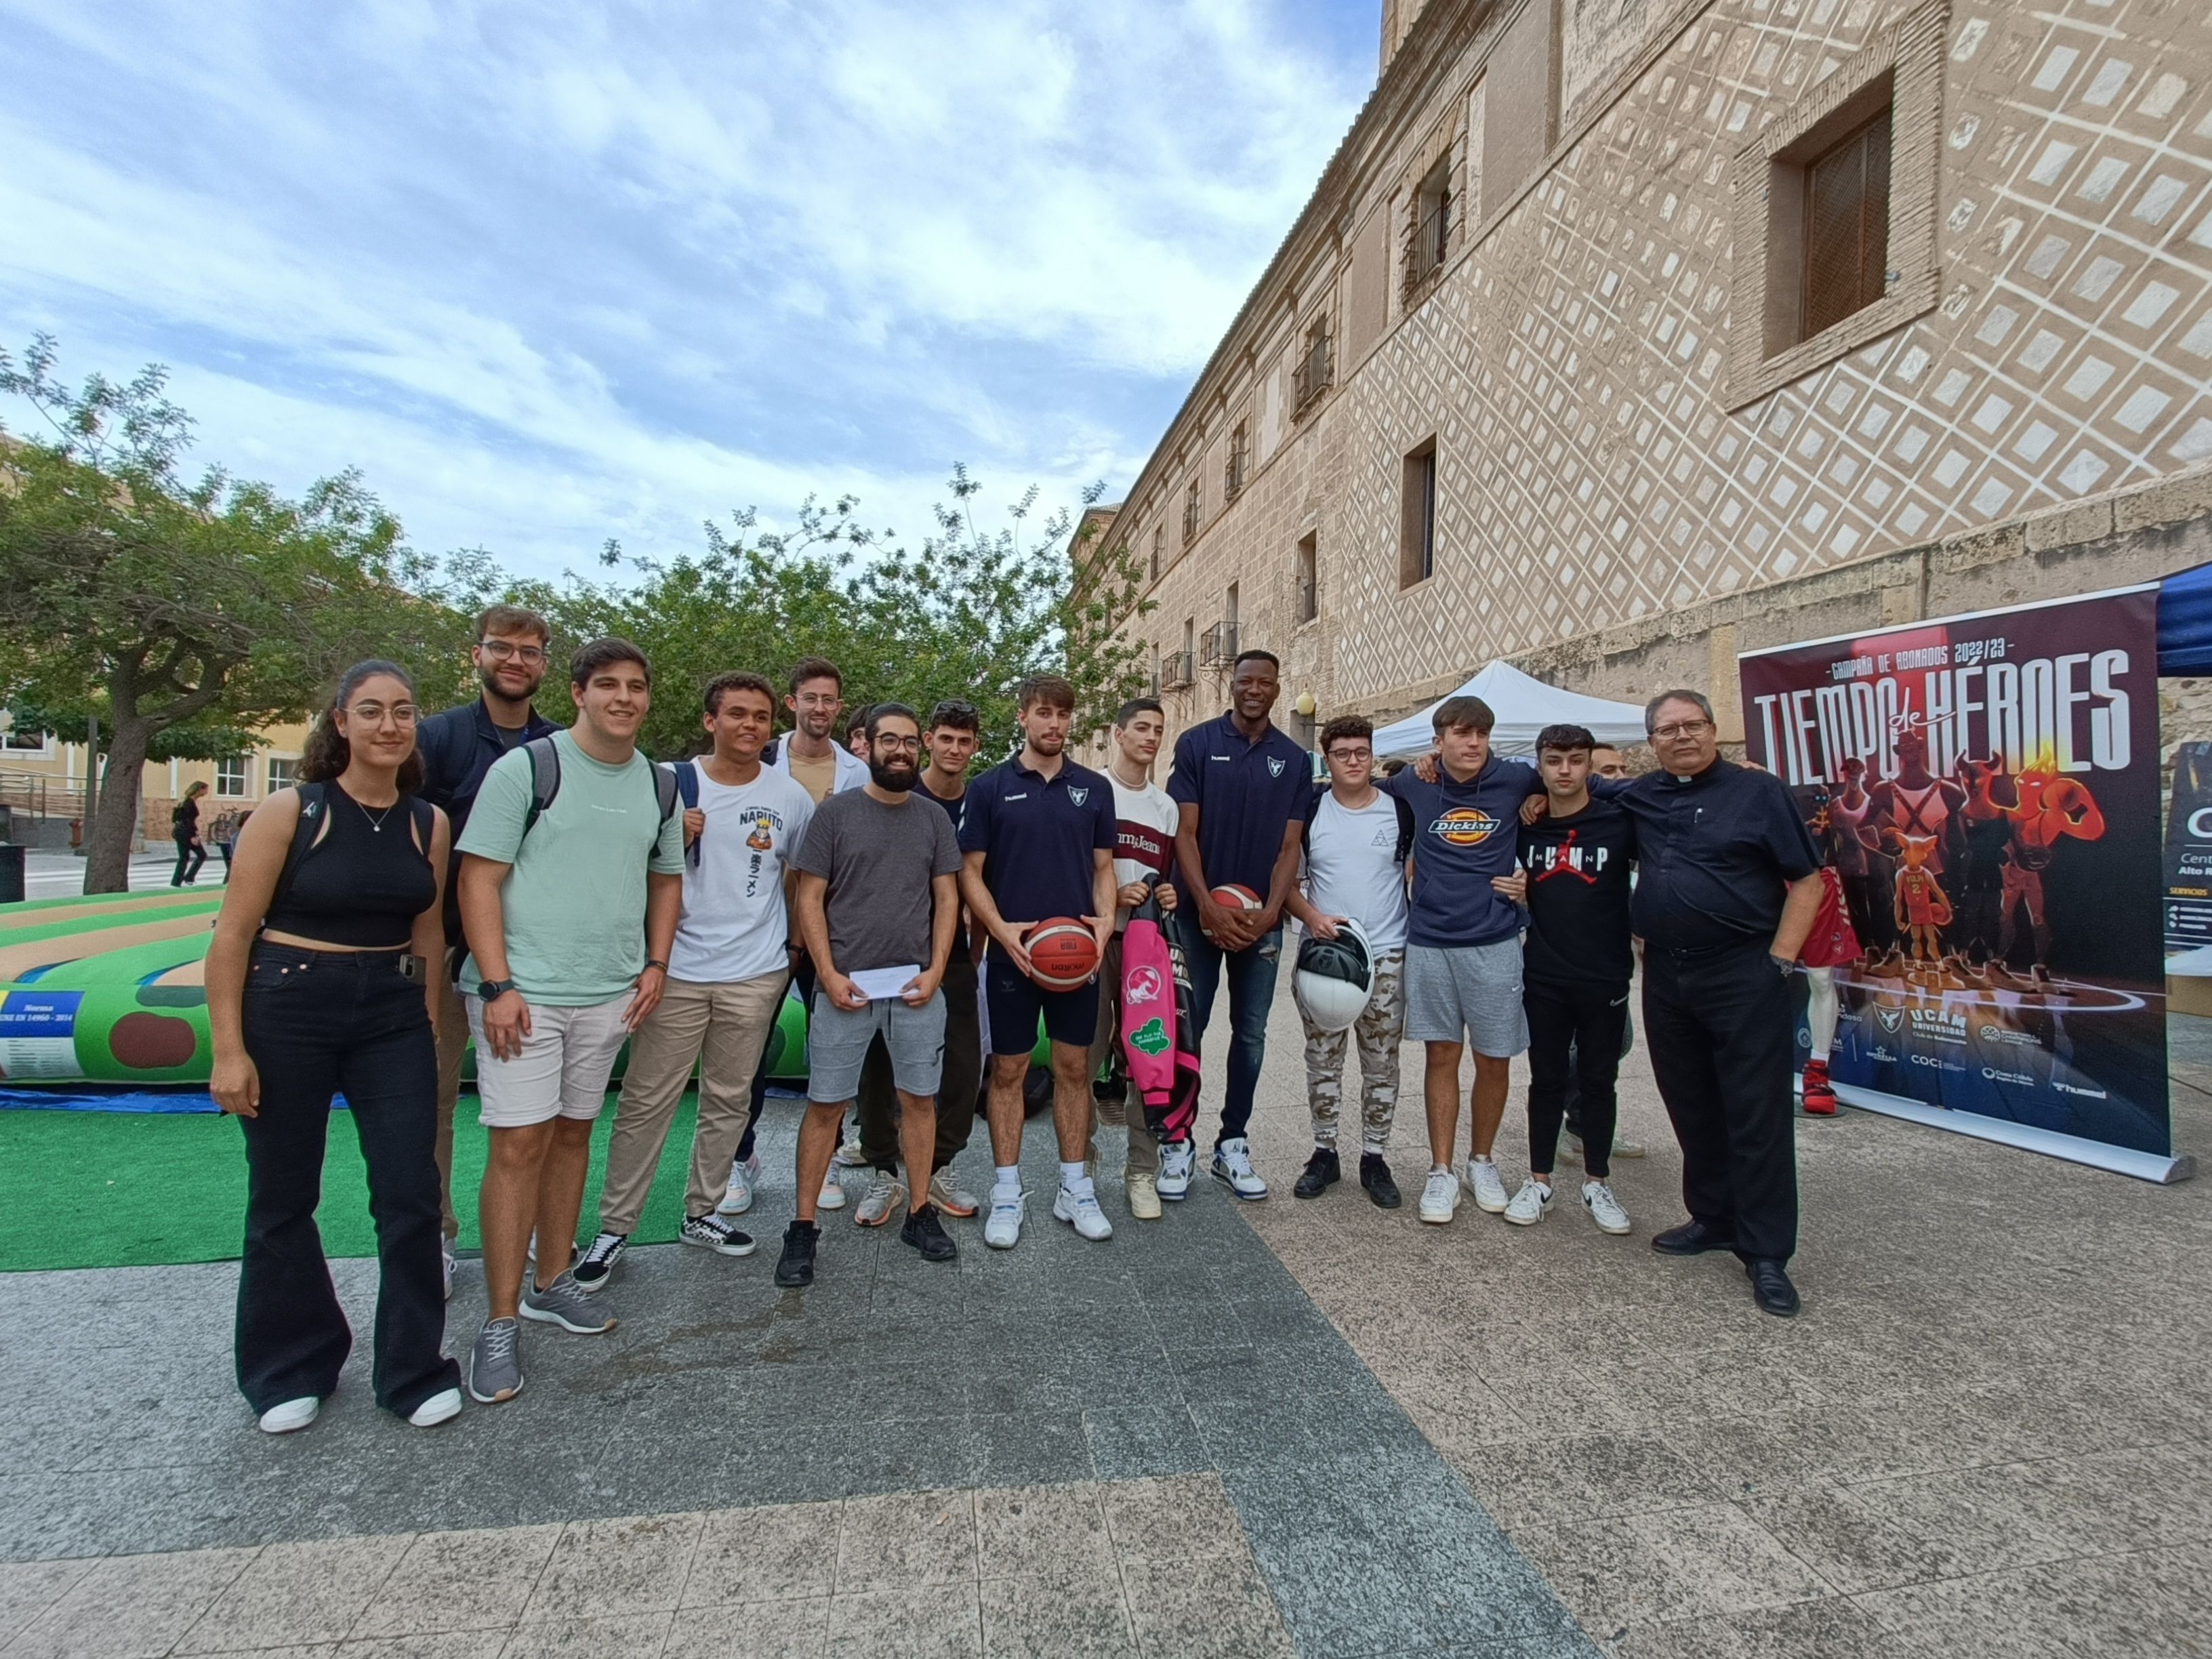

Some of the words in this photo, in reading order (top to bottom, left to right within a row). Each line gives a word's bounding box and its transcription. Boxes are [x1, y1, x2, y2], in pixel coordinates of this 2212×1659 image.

[1878, 653, 1890, 674] DE
[1896, 646, 1948, 670] ABONADOS
[1754, 676, 1898, 786] TIEMPO
[1888, 687, 1957, 730] de
[1925, 649, 2131, 779] HÉROES
[1004, 792, 1027, 802] hummel
[739, 811, 783, 832] NARUTO
[1435, 821, 1494, 832] Dickies
[1527, 845, 1608, 872] JUMP
[2178, 866, 2203, 875] Alto
[1912, 883, 1921, 894] 2
[1051, 962, 1085, 972] molten
[1910, 1008, 1967, 1028] UCAM
[1912, 1021, 1966, 1036] UNIVERSIDAD
[2066, 1084, 2106, 1099] hummel
